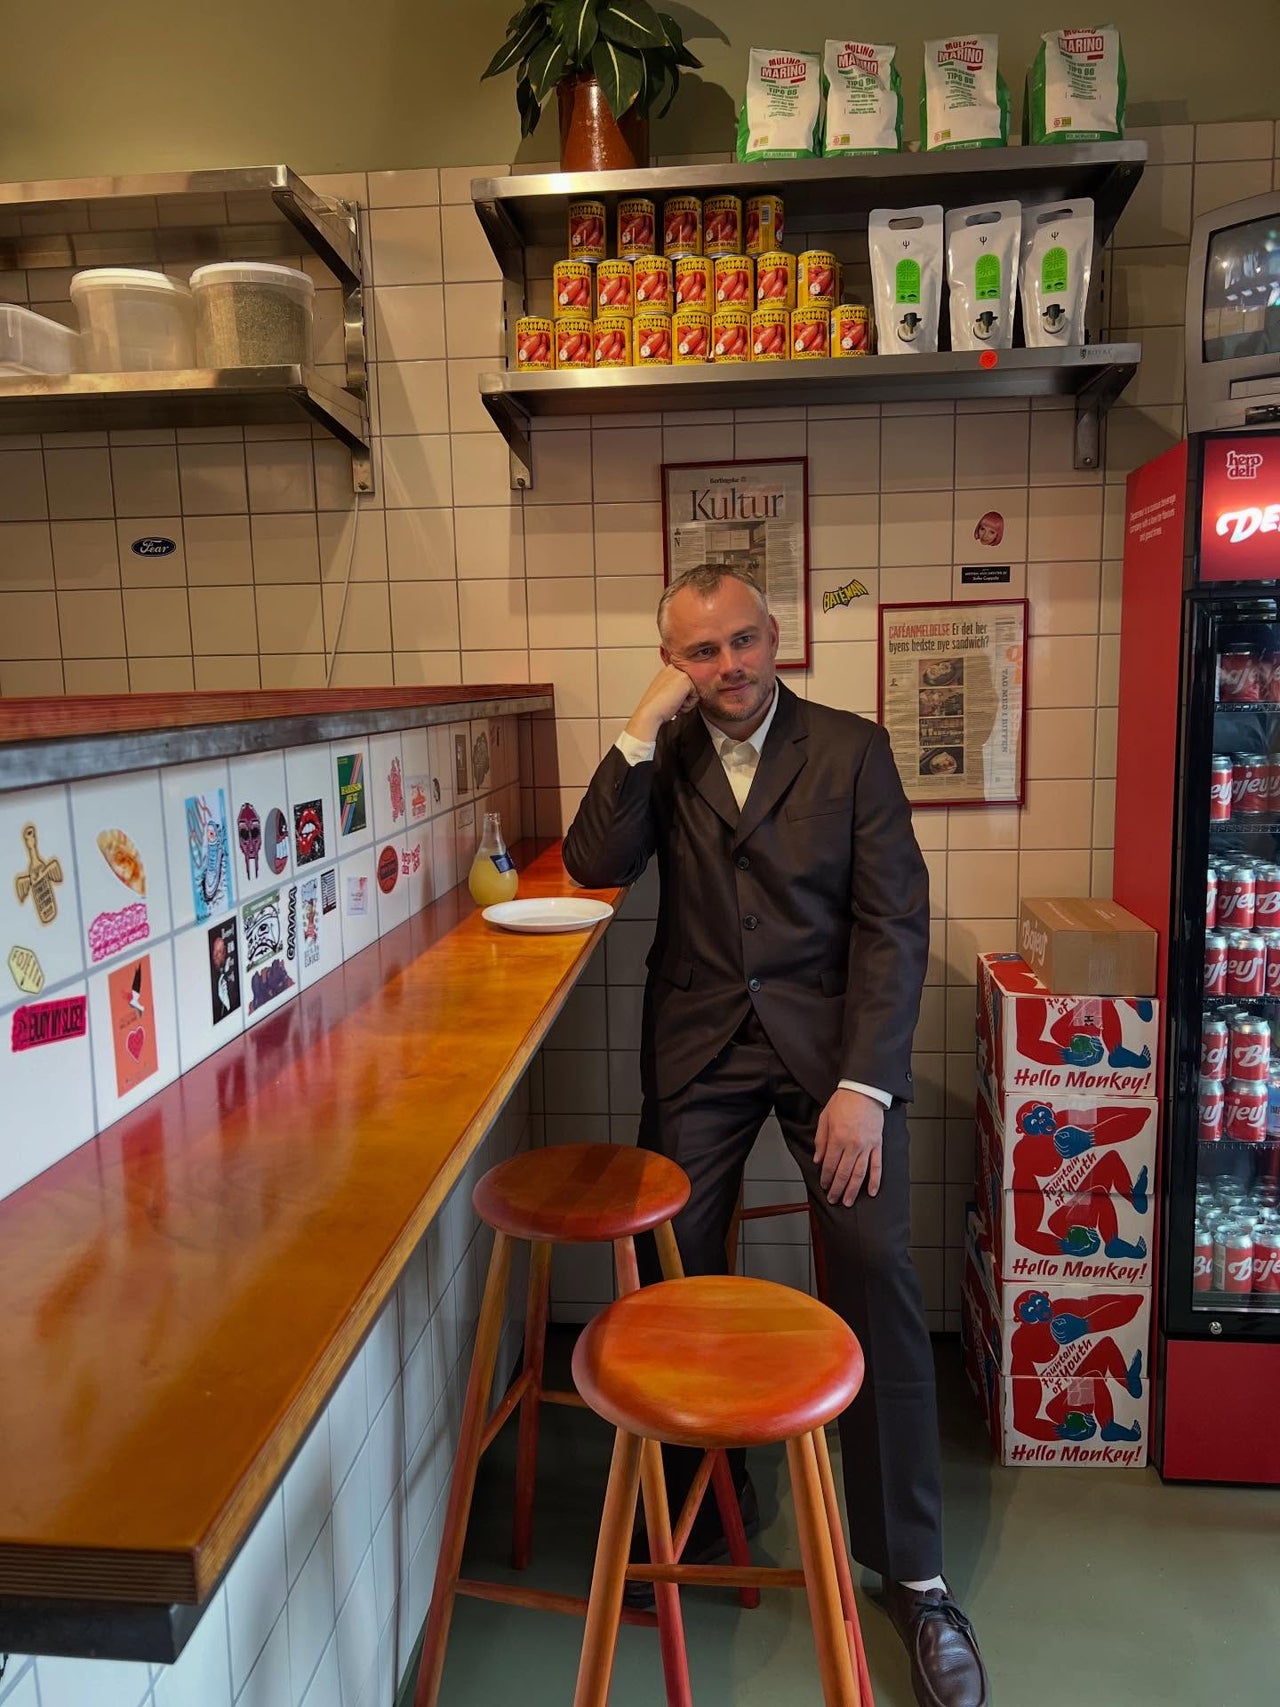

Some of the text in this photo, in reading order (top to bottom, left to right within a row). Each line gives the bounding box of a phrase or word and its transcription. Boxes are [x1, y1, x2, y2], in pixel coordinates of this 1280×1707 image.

[845, 43, 875, 58] MULINO
[945, 40, 978, 50] MULINO
[1058, 36, 1104, 53] MARINO
[768, 57, 801, 66] MULINO
[938, 47, 984, 63] MARINO
[761, 63, 806, 80] MARINO
[1228, 452, 1262, 467] hero
[1228, 465, 1256, 478] deli
[690, 488, 784, 521] Kultur
[1216, 504, 1280, 543] DE
[823, 579, 869, 614] BATEMAN
[952, 623, 959, 635] Er
[961, 622, 973, 634] det
[976, 622, 988, 634] her
[889, 636, 990, 654] byens bedste nye sandwich?
[1014, 1068, 1151, 1094] Hello Monkey!
[1043, 1157, 1081, 1200] Fountain
[1064, 1152, 1097, 1192] Youth
[1012, 1258, 1148, 1283] Hello Monkey!
[1059, 1339, 1093, 1381] Youth
[1011, 1444, 1143, 1466] Hello Monkey!
